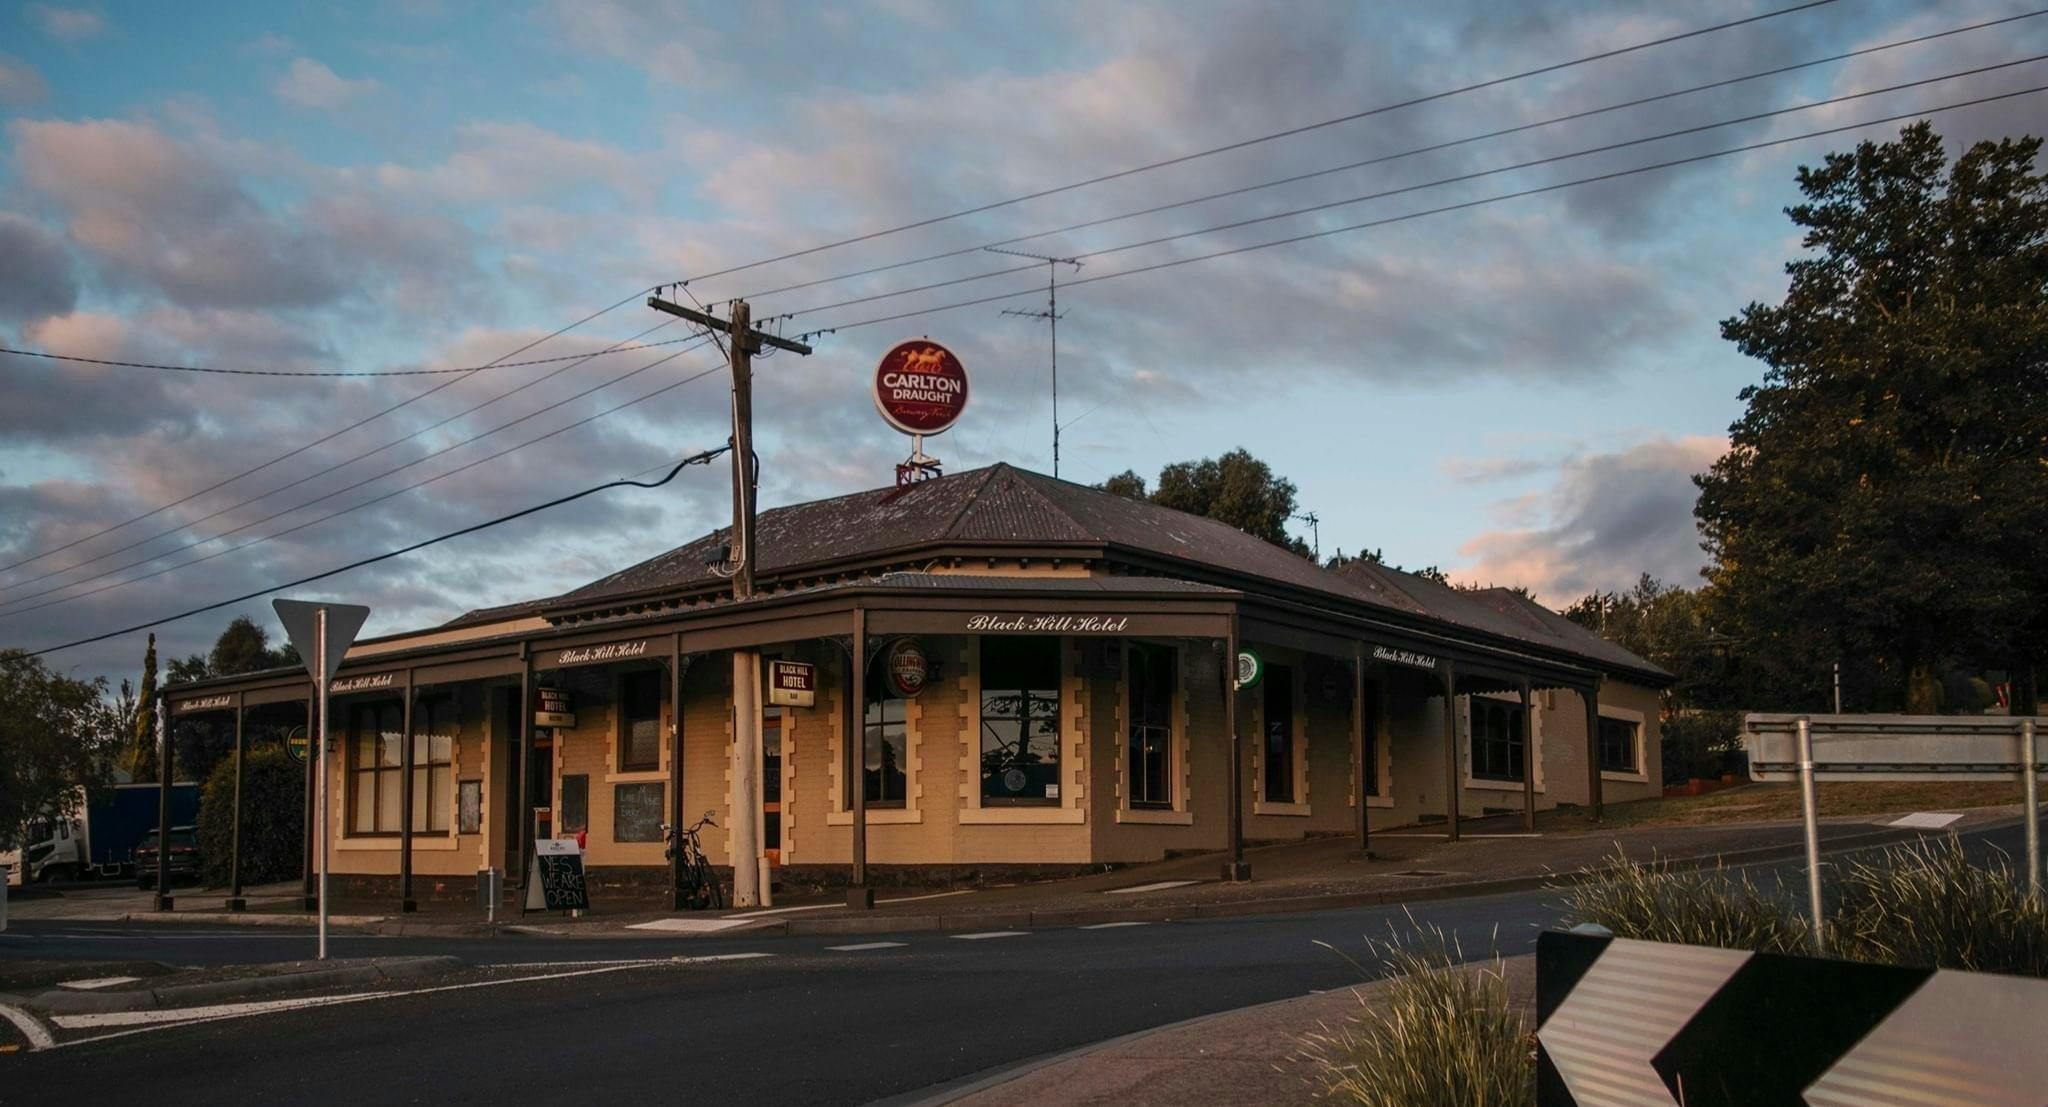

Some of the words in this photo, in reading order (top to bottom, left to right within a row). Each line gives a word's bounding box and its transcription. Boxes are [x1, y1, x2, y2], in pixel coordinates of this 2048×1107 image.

[883, 373, 961, 394] CARLTON
[893, 389, 953, 404] DRAUGHT
[967, 614, 1025, 631] Black
[1028, 614, 1073, 632] Hill
[1072, 616, 1128, 632] Hotel
[558, 649, 591, 664] Black
[591, 645, 616, 661] Hill
[615, 641, 647, 658] Hotel
[1373, 645, 1398, 662] Black
[1398, 651, 1416, 665] Hill
[1415, 655, 1437, 669] Hotel
[780, 664, 797, 675] BLACK
[797, 666, 808, 676] HILL
[329, 680, 352, 692] Black
[352, 678, 374, 690] Hill
[370, 674, 392, 688] Hotel
[783, 675, 806, 689] HOTEL
[541, 690, 558, 700] BLACK
[544, 700, 569, 712] HOTEL
[543, 855, 573, 875] YES
[542, 871, 560, 889] WE
[561, 873, 584, 890] ARE
[546, 887, 584, 906] OPEN
